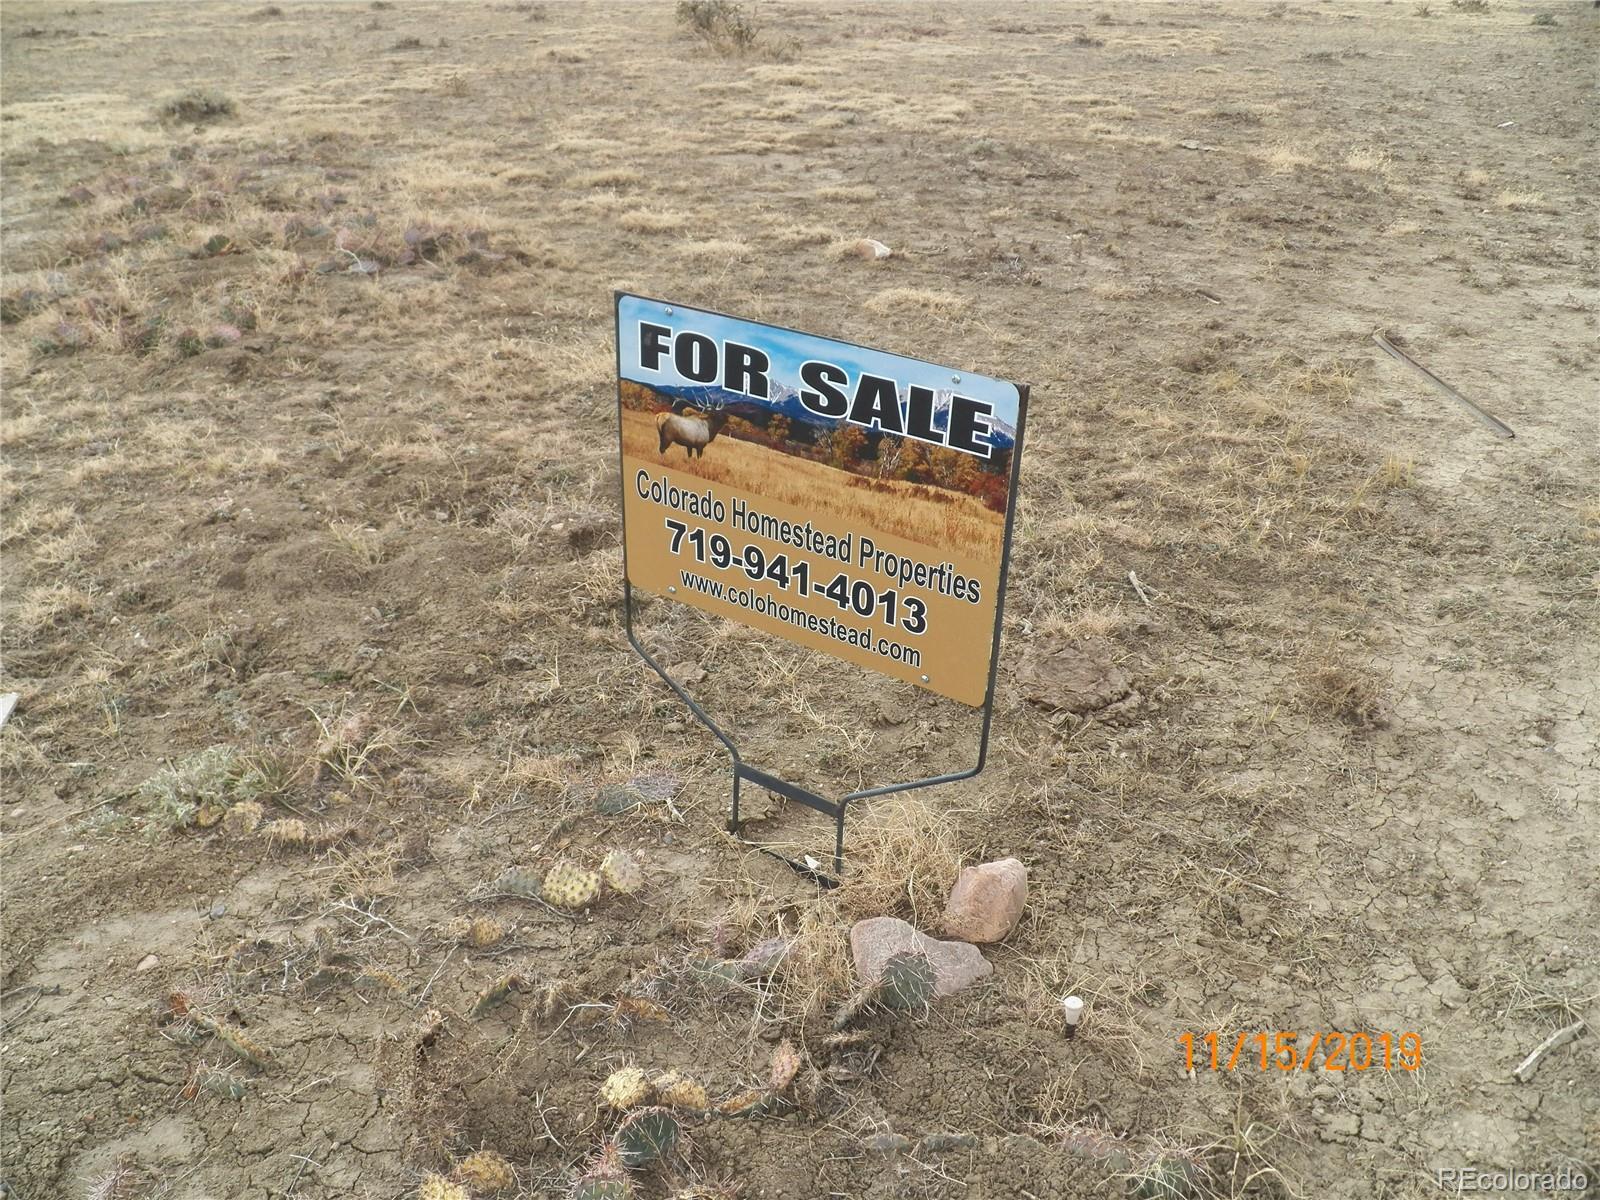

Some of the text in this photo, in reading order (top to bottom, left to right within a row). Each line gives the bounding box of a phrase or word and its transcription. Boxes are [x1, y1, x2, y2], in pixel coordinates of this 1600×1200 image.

[638, 320, 995, 458] FOR SALE
[636, 469, 981, 604] Colorado Homestead Properties
[664, 518, 928, 635] 719-941-4013
[681, 570, 922, 668] www.colohomestead.com
